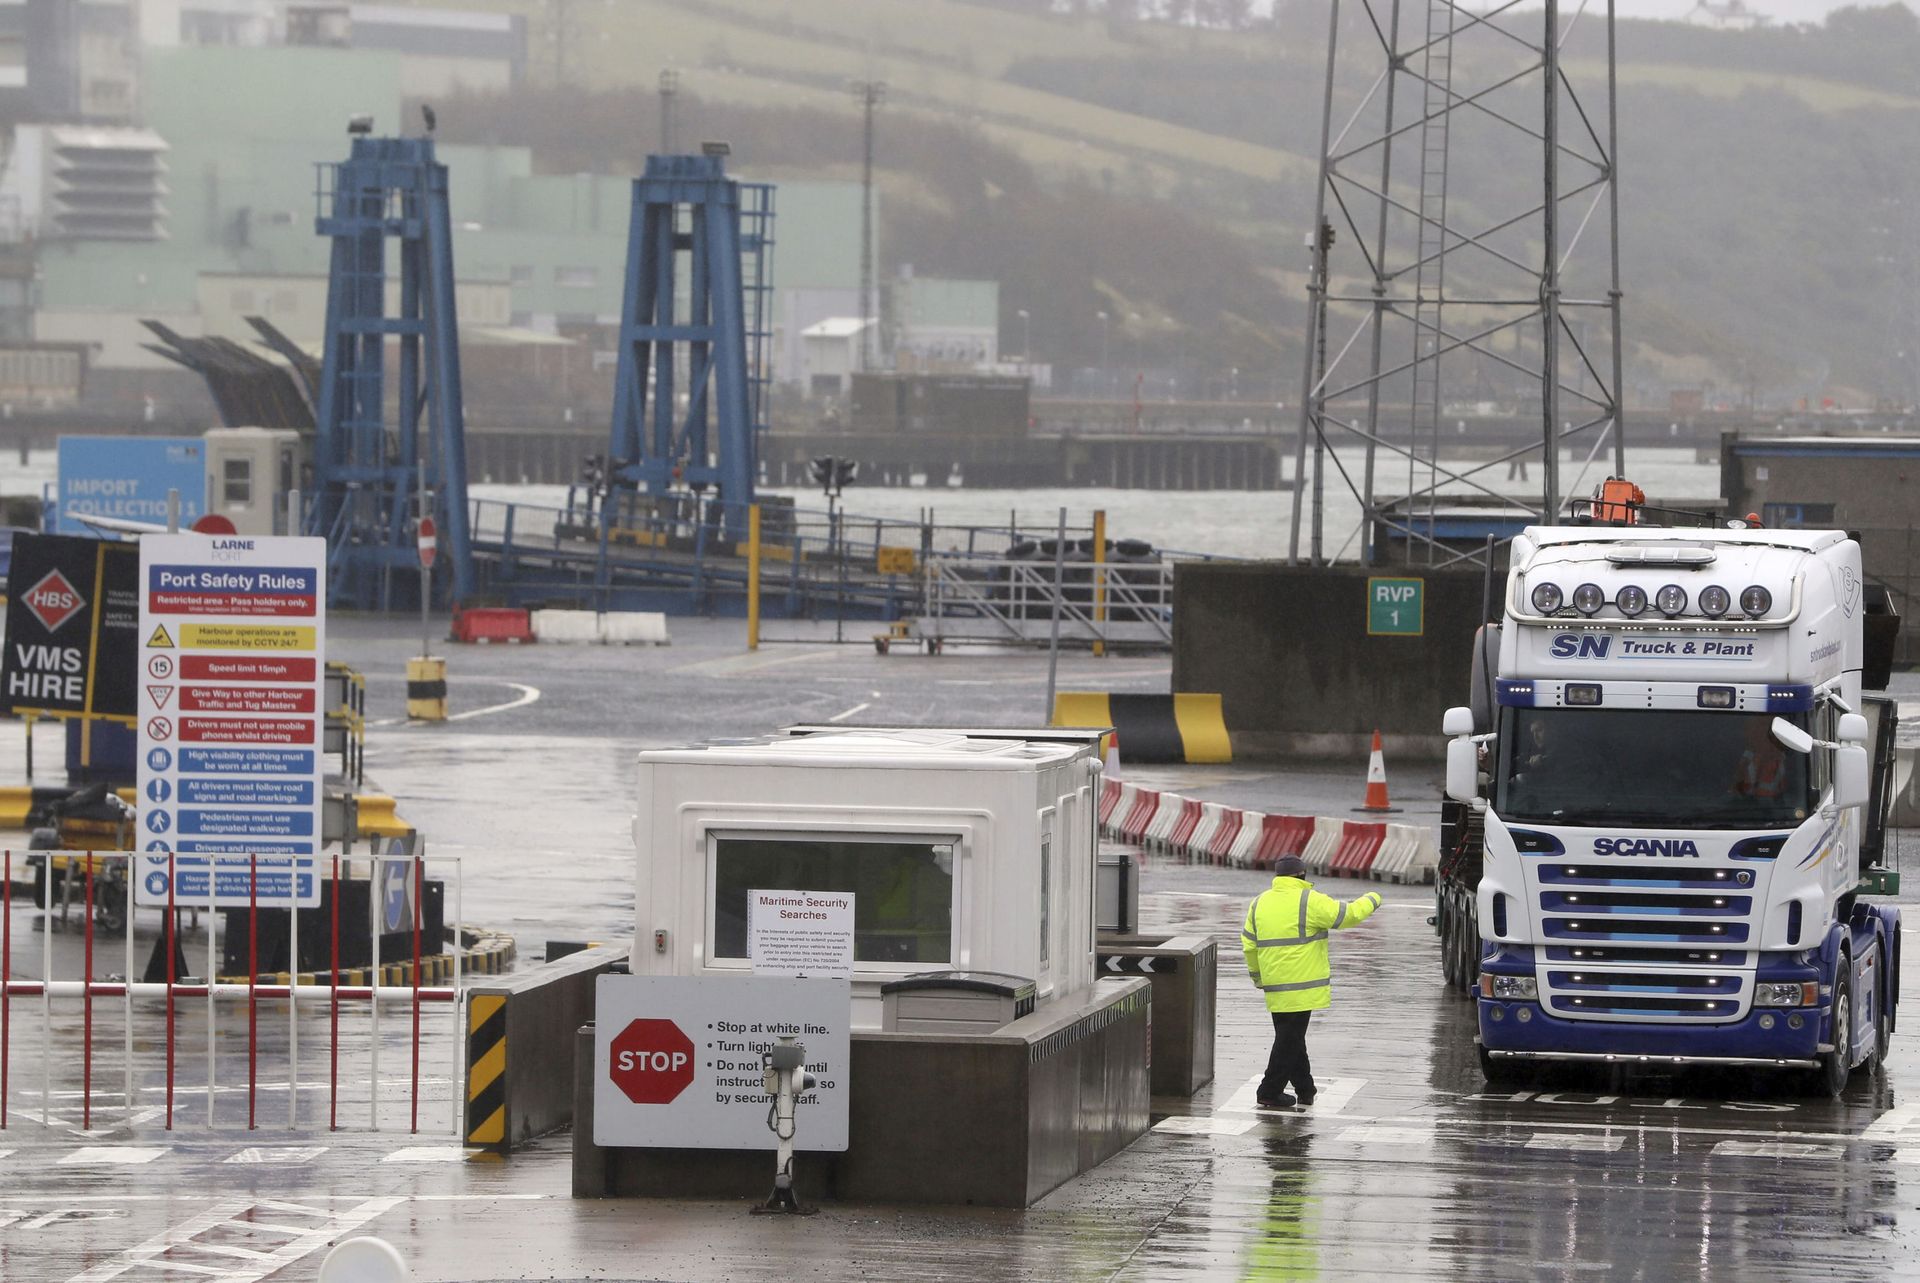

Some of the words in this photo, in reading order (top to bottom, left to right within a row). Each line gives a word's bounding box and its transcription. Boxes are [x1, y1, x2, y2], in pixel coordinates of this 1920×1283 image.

[68, 479, 138, 495] IMPORT
[67, 499, 181, 516] COLLECTIO
[212, 540, 255, 550] LARNE
[211, 551, 242, 561] PORT
[160, 572, 196, 587] Port
[201, 573, 254, 591] Safety
[258, 574, 306, 590] Rules
[33, 590, 73, 609] HBS
[1376, 586, 1415, 602] RVP
[157, 595, 202, 605] Restricted
[230, 597, 252, 606] Pass
[253, 597, 286, 607] holders
[288, 599, 308, 609] only.
[1390, 610, 1399, 626] 1
[199, 627, 233, 635] Harbour
[235, 628, 281, 638] operations
[196, 638, 240, 646] monitored
[241, 638, 252, 648] by
[280, 639, 298, 647] 24/7
[1551, 634, 1612, 658] SN
[1622, 640, 1676, 654] Truck
[1682, 641, 1696, 655] &
[1702, 642, 1754, 656] Plant
[16, 643, 82, 673] VMS
[153, 662, 167, 672] 15
[208, 663, 236, 673] Speed
[237, 664, 256, 673] limit
[258, 665, 287, 674] 15mph
[9, 671, 84, 701] HIRE
[191, 688, 211, 697] Give
[212, 689, 231, 699] Way
[232, 690, 242, 698] to
[243, 690, 266, 698] other
[267, 691, 303, 700] Harbour
[198, 699, 225, 708] Traffic
[226, 700, 242, 709] and
[244, 701, 259, 711] Tug
[261, 701, 297, 710] Masters
[187, 720, 218, 729] Drivers
[220, 721, 242, 729] must
[243, 722, 258, 730] not
[276, 722, 306, 731] mobile
[201, 731, 233, 740] phones
[234, 731, 260, 740] whilst
[261, 732, 291, 742] driving
[188, 751, 209, 760] High
[210, 751, 244, 762] visibility
[245, 752, 280, 763] clothing
[282, 753, 304, 761] must
[204, 762, 216, 770] be
[263, 763, 288, 771] times
[188, 782, 200, 790] All
[201, 782, 231, 790] drivers
[232, 783, 254, 791] must
[255, 783, 281, 791] follow
[283, 784, 303, 792] road
[193, 793, 217, 802] signs
[218, 793, 235, 801] and
[236, 794, 256, 802] road
[257, 794, 297, 804] markings
[199, 813, 250, 822] Pedestrians
[252, 815, 273, 823] must
[199, 823, 247, 834] designated
[249, 824, 290, 834] walkways
[195, 844, 226, 852] Drivers
[245, 846, 295, 854] passengers
[1593, 837, 1699, 858] SCANIA
[242, 876, 273, 884] becons
[223, 885, 247, 893] driving
[249, 885, 276, 893] trough
[760, 896, 803, 907] Maritime
[806, 897, 848, 910] Security
[780, 909, 827, 920] Searches
[717, 1021, 747, 1034] Stop
[750, 1022, 763, 1033] at
[766, 1023, 800, 1034] white
[803, 1023, 830, 1035] line.
[717, 1040, 745, 1052] Turn
[748, 1041, 775, 1054] ligh
[617, 1051, 688, 1072] STOP
[717, 1059, 735, 1071] Do
[738, 1061, 759, 1071] not
[820, 1080, 836, 1089] so
[716, 1092, 731, 1105] by
[734, 1094, 774, 1104] securi
[795, 1094, 820, 1105] taff.
